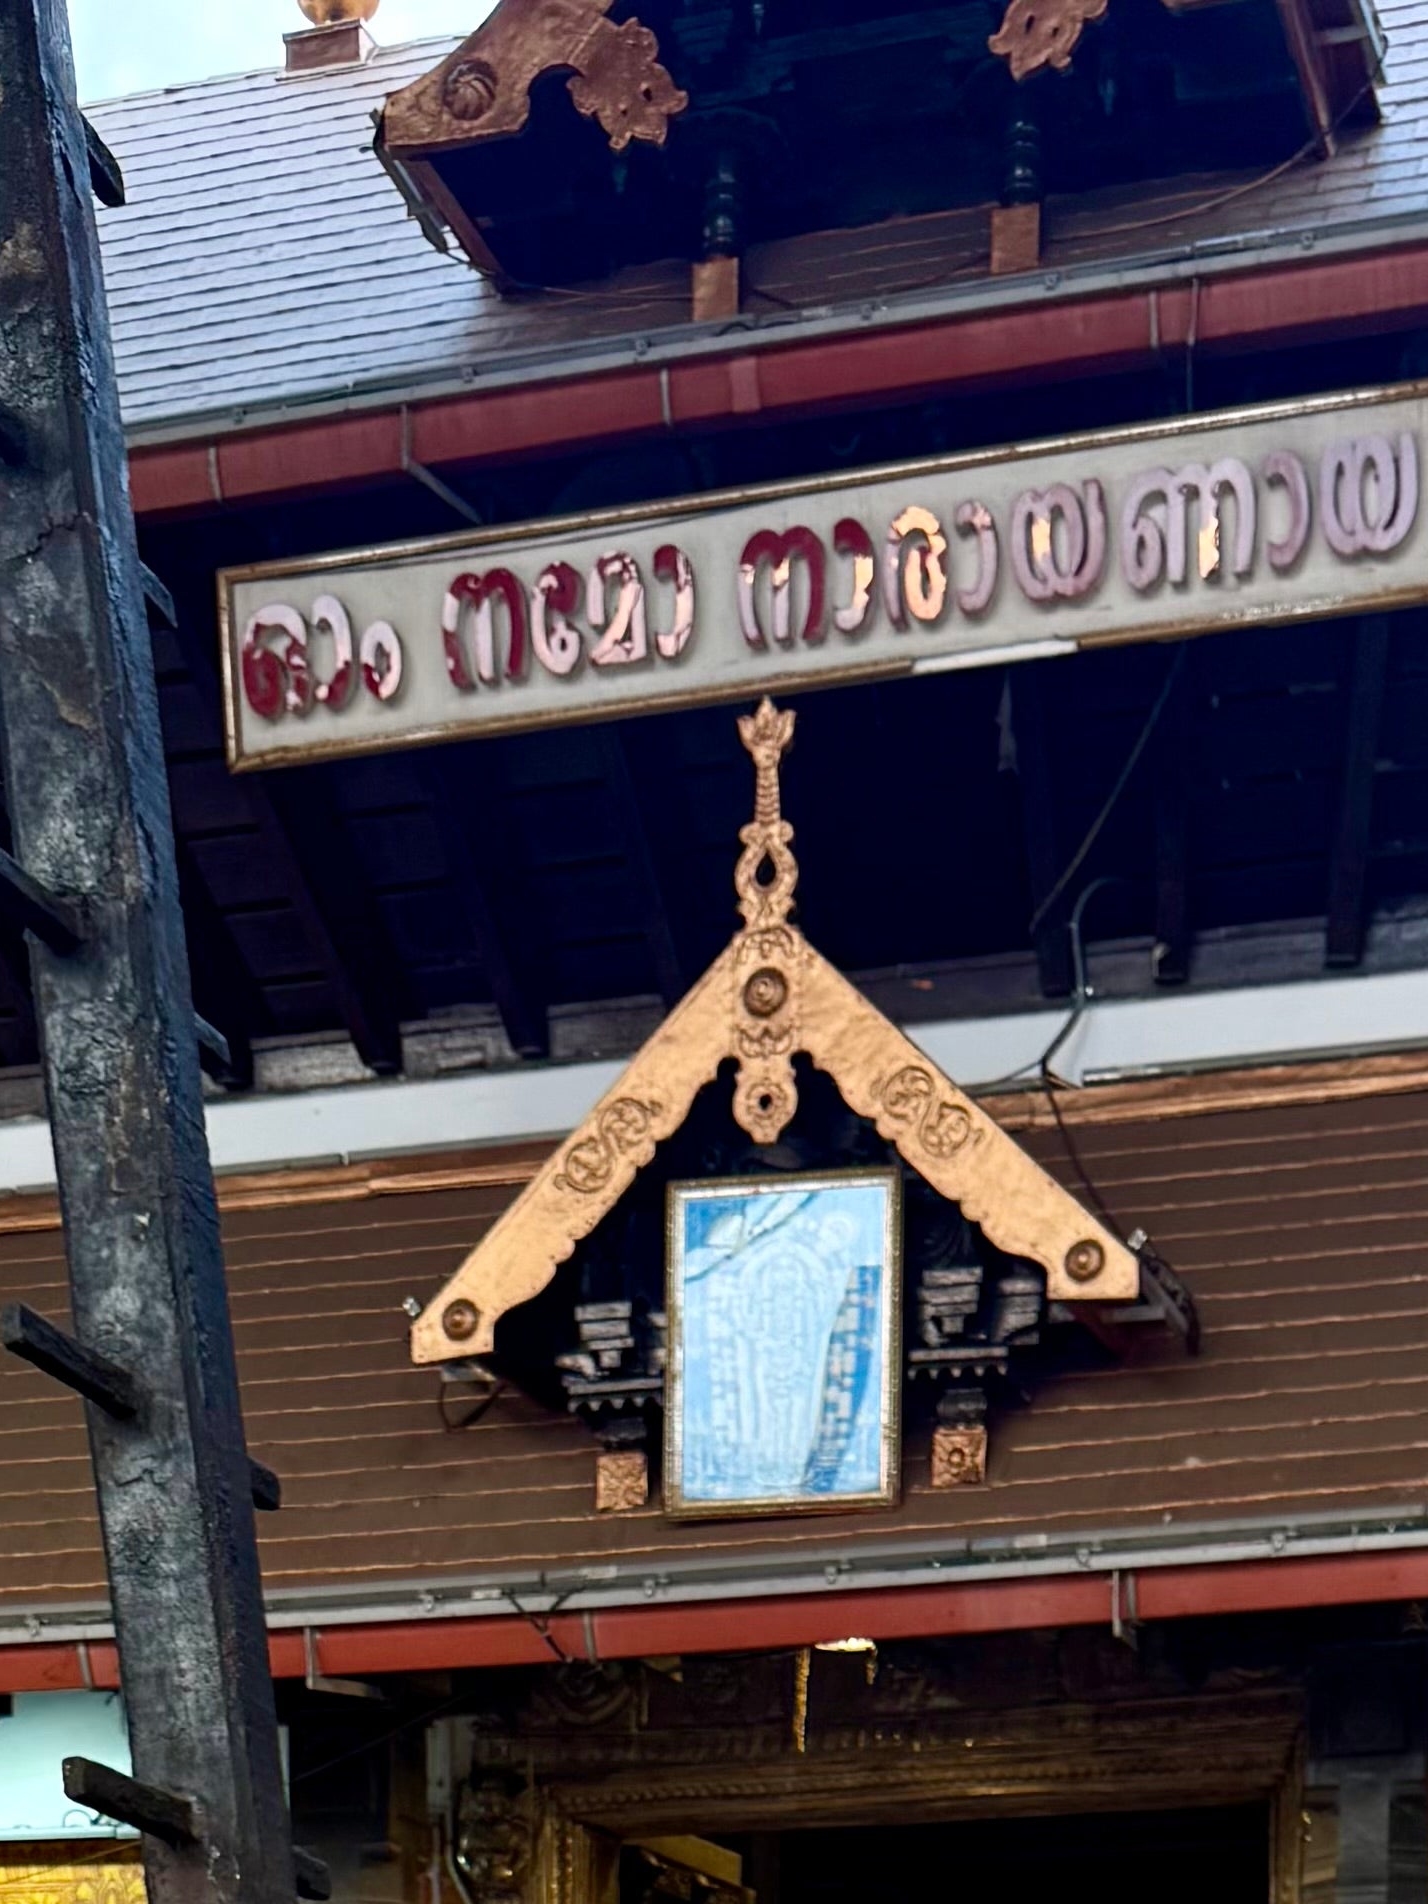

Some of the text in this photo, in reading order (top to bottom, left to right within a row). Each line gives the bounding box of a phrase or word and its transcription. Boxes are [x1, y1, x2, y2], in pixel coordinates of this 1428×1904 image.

[244, 433, 1419, 718] ഓം നമോ നാരായണായ
